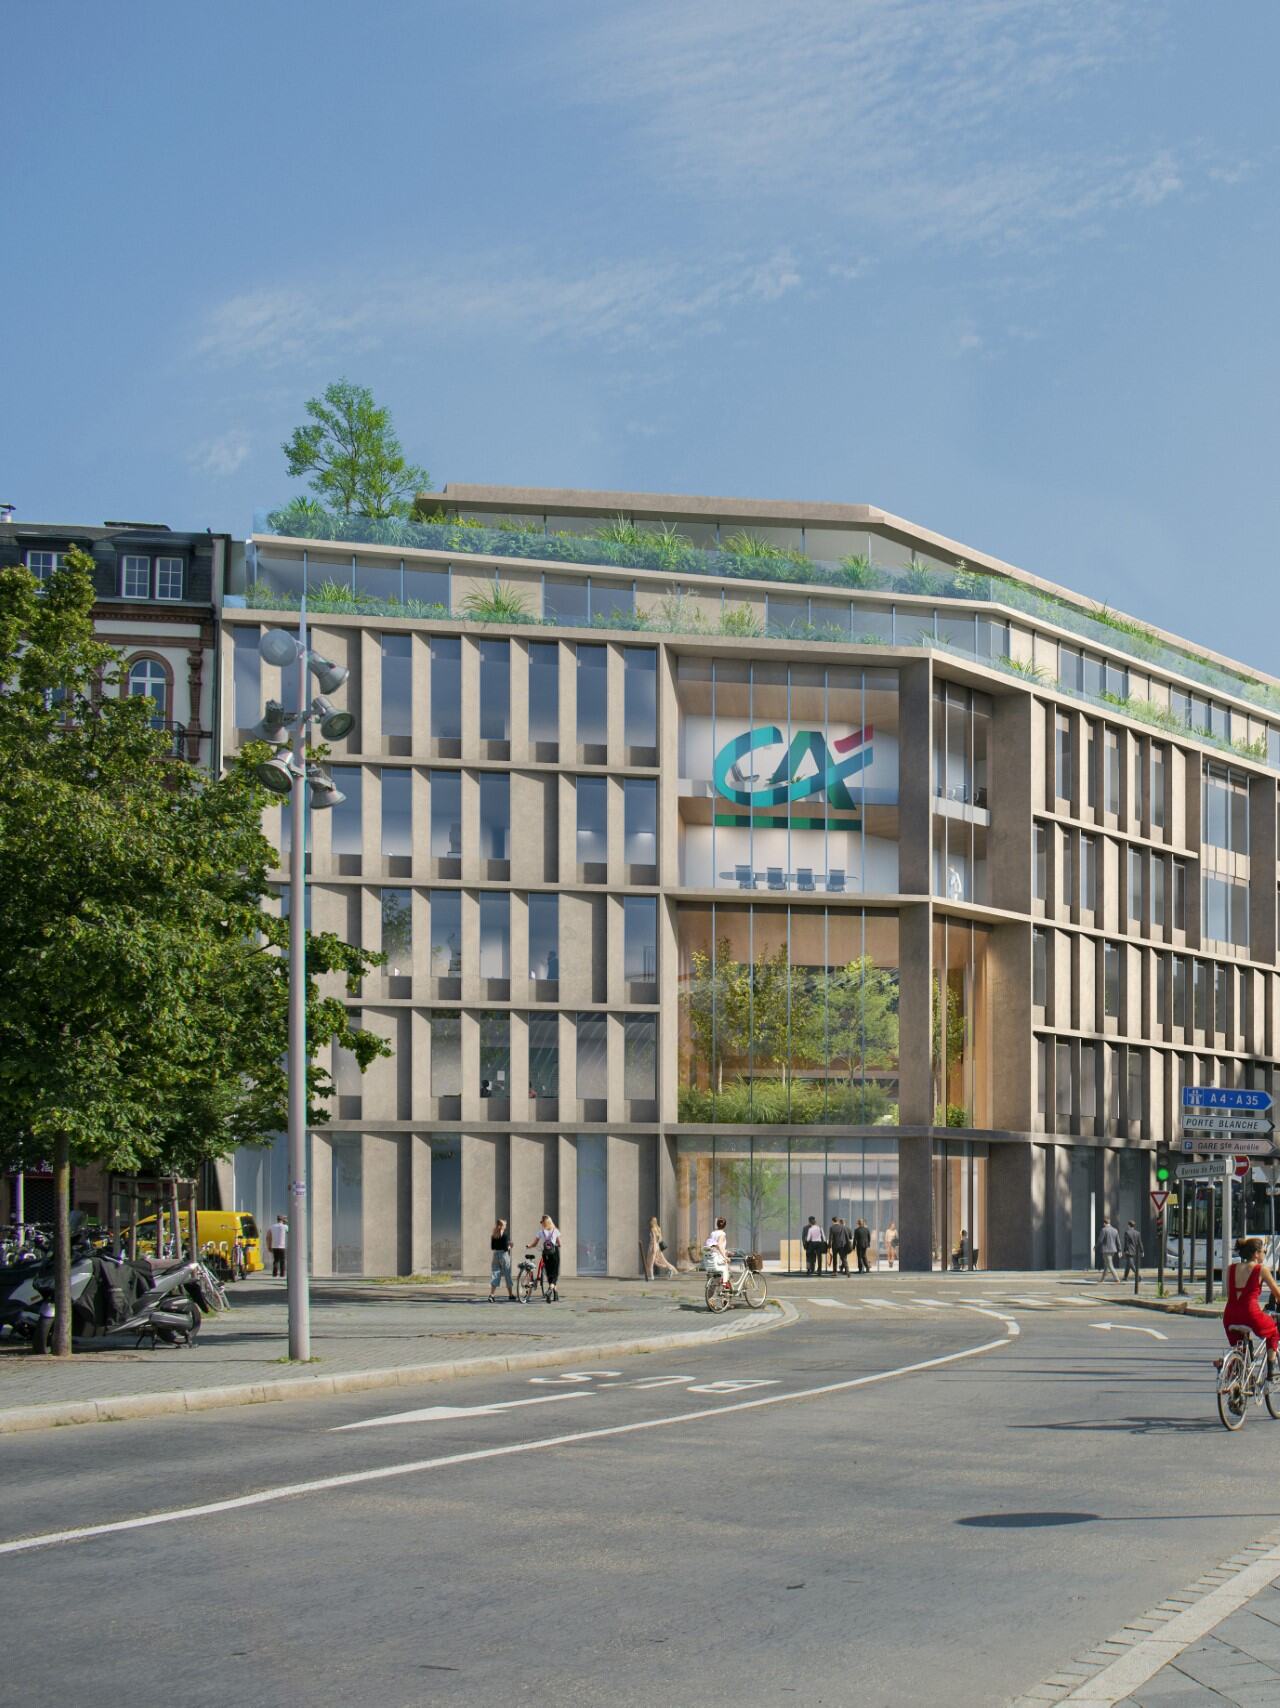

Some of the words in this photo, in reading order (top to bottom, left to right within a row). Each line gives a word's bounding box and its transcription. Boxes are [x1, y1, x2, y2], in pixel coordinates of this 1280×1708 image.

[712, 724, 874, 810] CA
[1186, 1118, 1214, 1128] PORTE
[1218, 1119, 1259, 1130] BLANCHE
[1198, 1142, 1218, 1150] GARE
